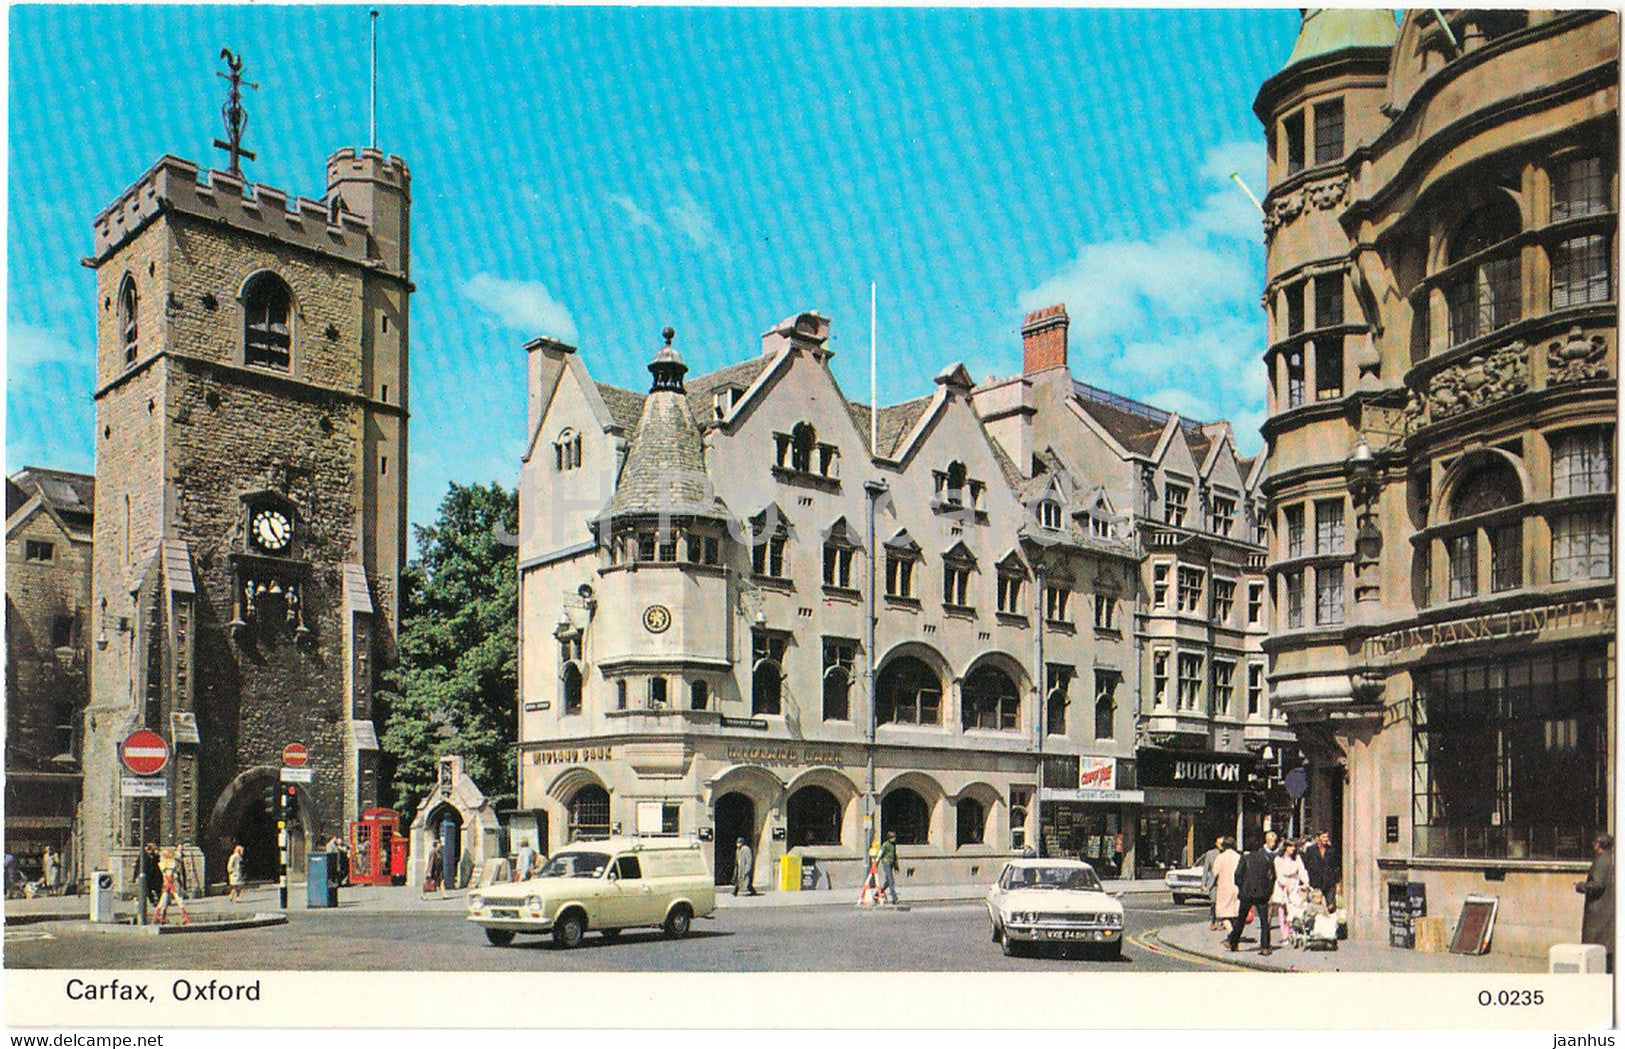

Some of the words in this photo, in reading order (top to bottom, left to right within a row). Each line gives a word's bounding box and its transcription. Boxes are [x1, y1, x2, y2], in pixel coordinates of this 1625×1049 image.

[1431, 614, 1494, 646] BANK
[533, 749, 579, 764] MIDLAND
[582, 745, 612, 762] BANK
[727, 746, 797, 760] MIDLAND
[1174, 761, 1240, 782] BURTON
